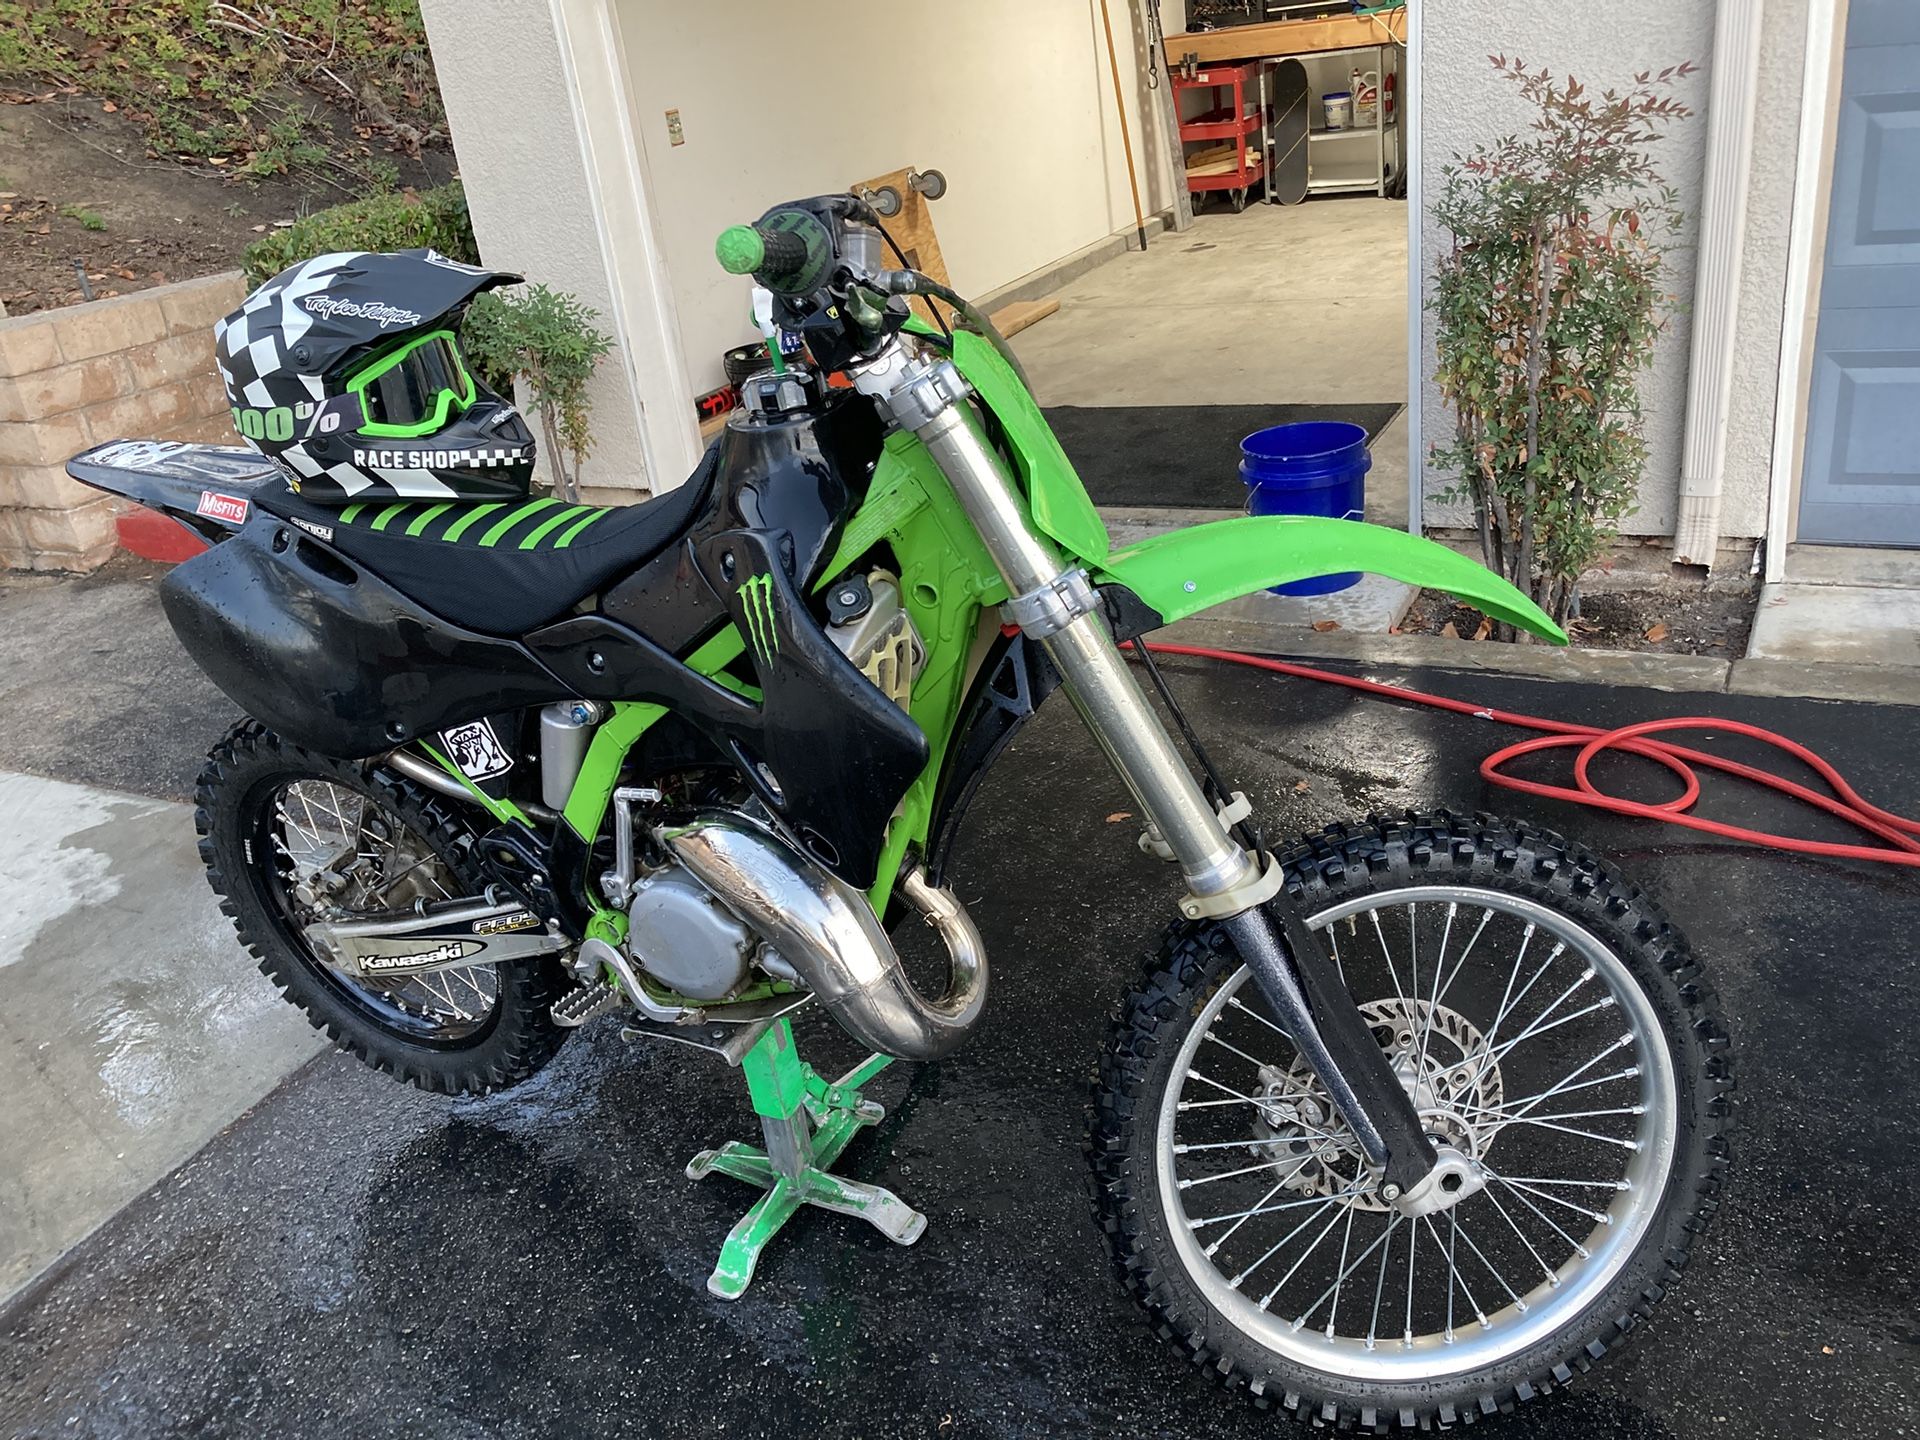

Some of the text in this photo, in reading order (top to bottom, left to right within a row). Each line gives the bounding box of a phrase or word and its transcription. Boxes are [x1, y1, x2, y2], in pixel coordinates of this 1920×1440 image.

[304, 295, 421, 328] Troy Lee Designs
[353, 449, 461, 469] RACE SHOP
[358, 942, 463, 970] Kawasaki
